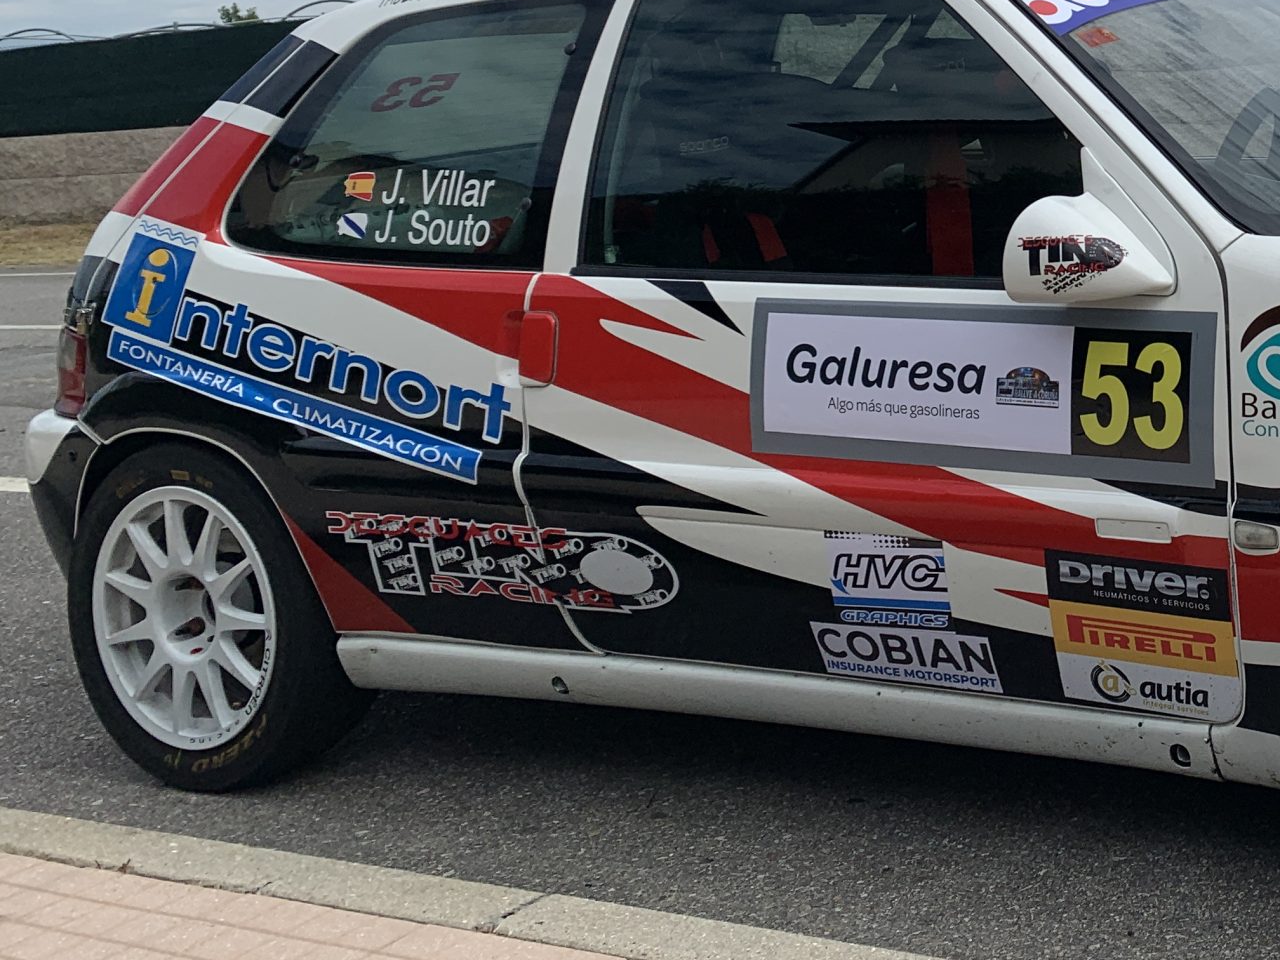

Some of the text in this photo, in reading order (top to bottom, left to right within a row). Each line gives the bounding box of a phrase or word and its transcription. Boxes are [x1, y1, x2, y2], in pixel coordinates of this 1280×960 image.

[381, 169, 495, 208] J. Villar
[374, 209, 491, 248] J. Souto
[786, 343, 987, 395] Galuresa
[116, 338, 245, 400] FONTANERÍA
[271, 397, 464, 471] CLIMATIZACIÓN
[827, 397, 980, 420] Algo más que gasolineras
[1079, 340, 1184, 450] 53
[840, 609, 949, 628] GRAPHICS
[1093, 590, 1150, 603] NEUMÁTICOS
[1162, 598, 1211, 611] SERVICIOS
[817, 628, 996, 675] COBIAN
[1066, 614, 1217, 662] PIRELLI
[827, 659, 997, 688] INSURANCE MOTORSPORT
[1140, 680, 1209, 708] autia
